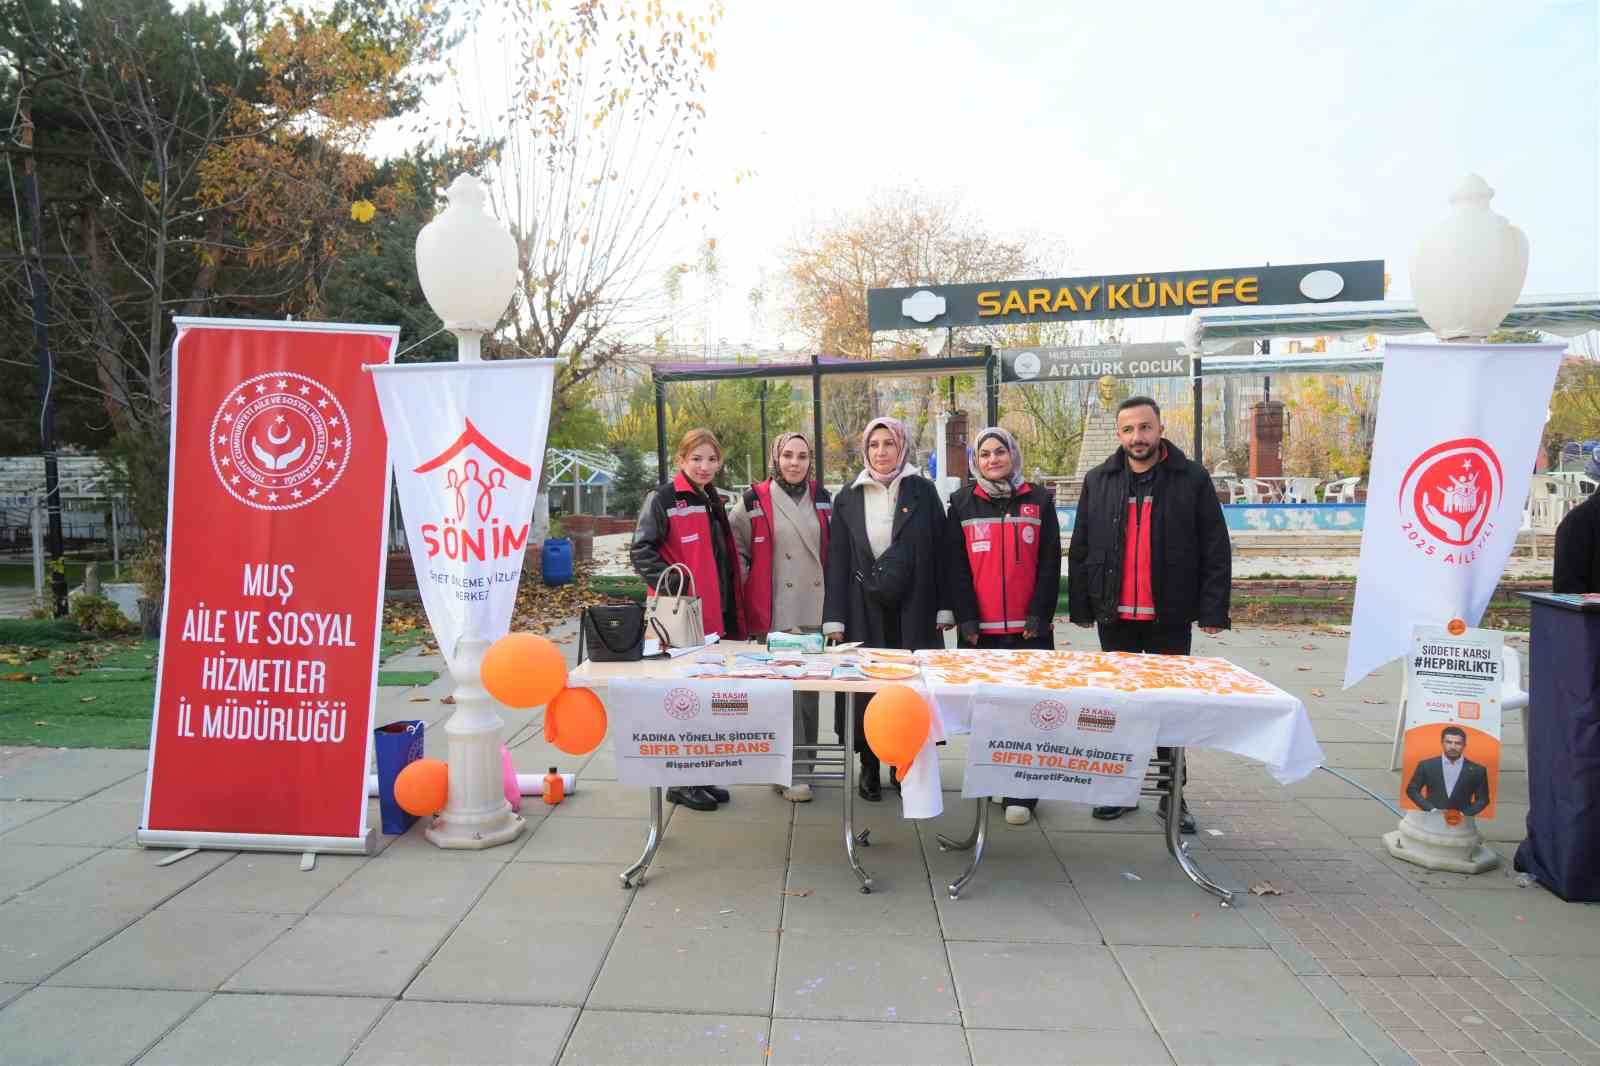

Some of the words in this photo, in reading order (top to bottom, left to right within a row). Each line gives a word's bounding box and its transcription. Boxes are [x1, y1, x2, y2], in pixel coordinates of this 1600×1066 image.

[977, 284, 1099, 317] SARAY
[1107, 277, 1259, 310] KÜNEFE
[1048, 359, 1124, 377] ATATÜRK
[1129, 359, 1184, 377] ÇOCUK
[421, 517, 529, 563] SÖNİM
[1402, 522, 1436, 556] 2025
[243, 563, 296, 606] MUŞ
[181, 602, 227, 643] AİLE
[234, 610, 261, 644] VE
[266, 612, 356, 647] SOSYAL
[201, 650, 327, 694] HİZMETLER
[177, 696, 195, 738] İL
[202, 699, 347, 744] MÜDÜRLÜĞÜ
[632, 732, 676, 742] KADINA
[679, 731, 726, 742] YÖNELİK
[728, 731, 776, 743] ŞİDDETE
[640, 744, 681, 755] SIFIR
[683, 742, 770, 755] TOLERANS
[988, 739, 1032, 751] KADINA
[1036, 743, 1084, 757] YÖNELİK
[1086, 747, 1134, 762] ŞİDDETE
[991, 751, 1032, 767] SIFIR
[1038, 755, 1125, 775] TOLERANS
